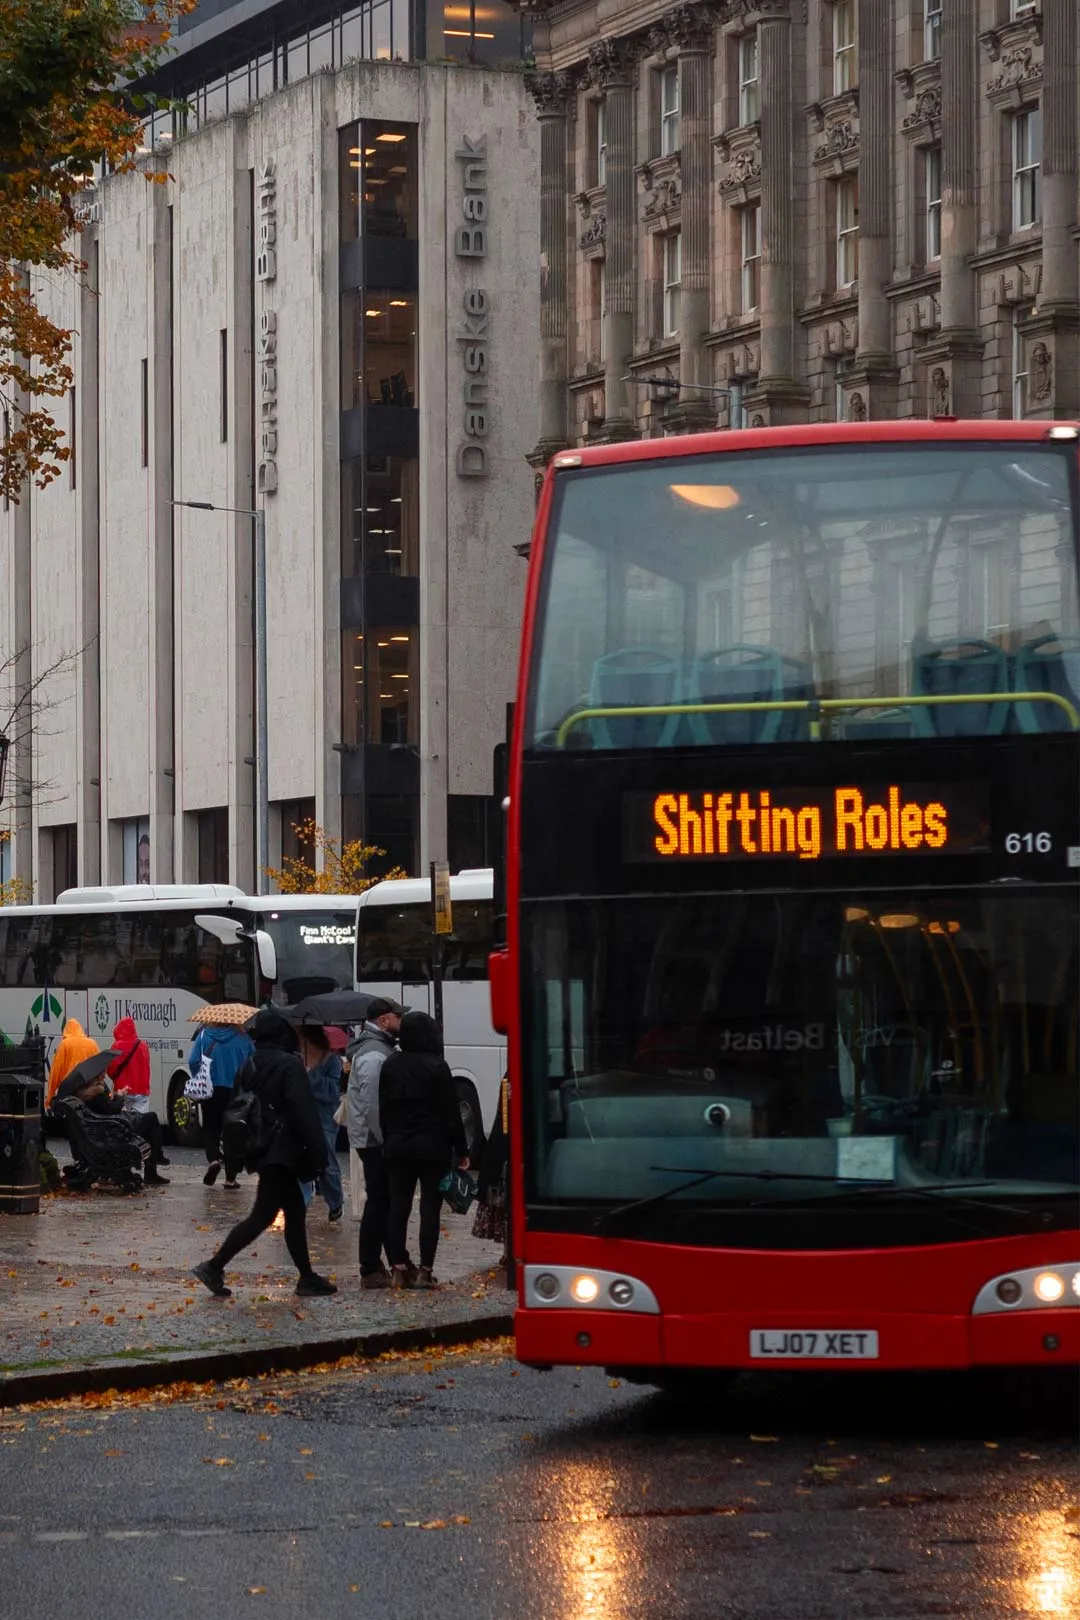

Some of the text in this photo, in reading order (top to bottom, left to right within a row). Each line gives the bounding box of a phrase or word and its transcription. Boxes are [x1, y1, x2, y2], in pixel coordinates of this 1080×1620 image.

[455, 133, 490, 478] Danske Bank
[257, 157, 277, 496] Danske Bank
[654, 786, 948, 859] Shifting Roles
[1005, 832, 1052, 854] 616
[320, 925, 351, 936] McCool
[125, 997, 177, 1028] Kavanagh
[759, 1333, 867, 1354] LJ07 XET
